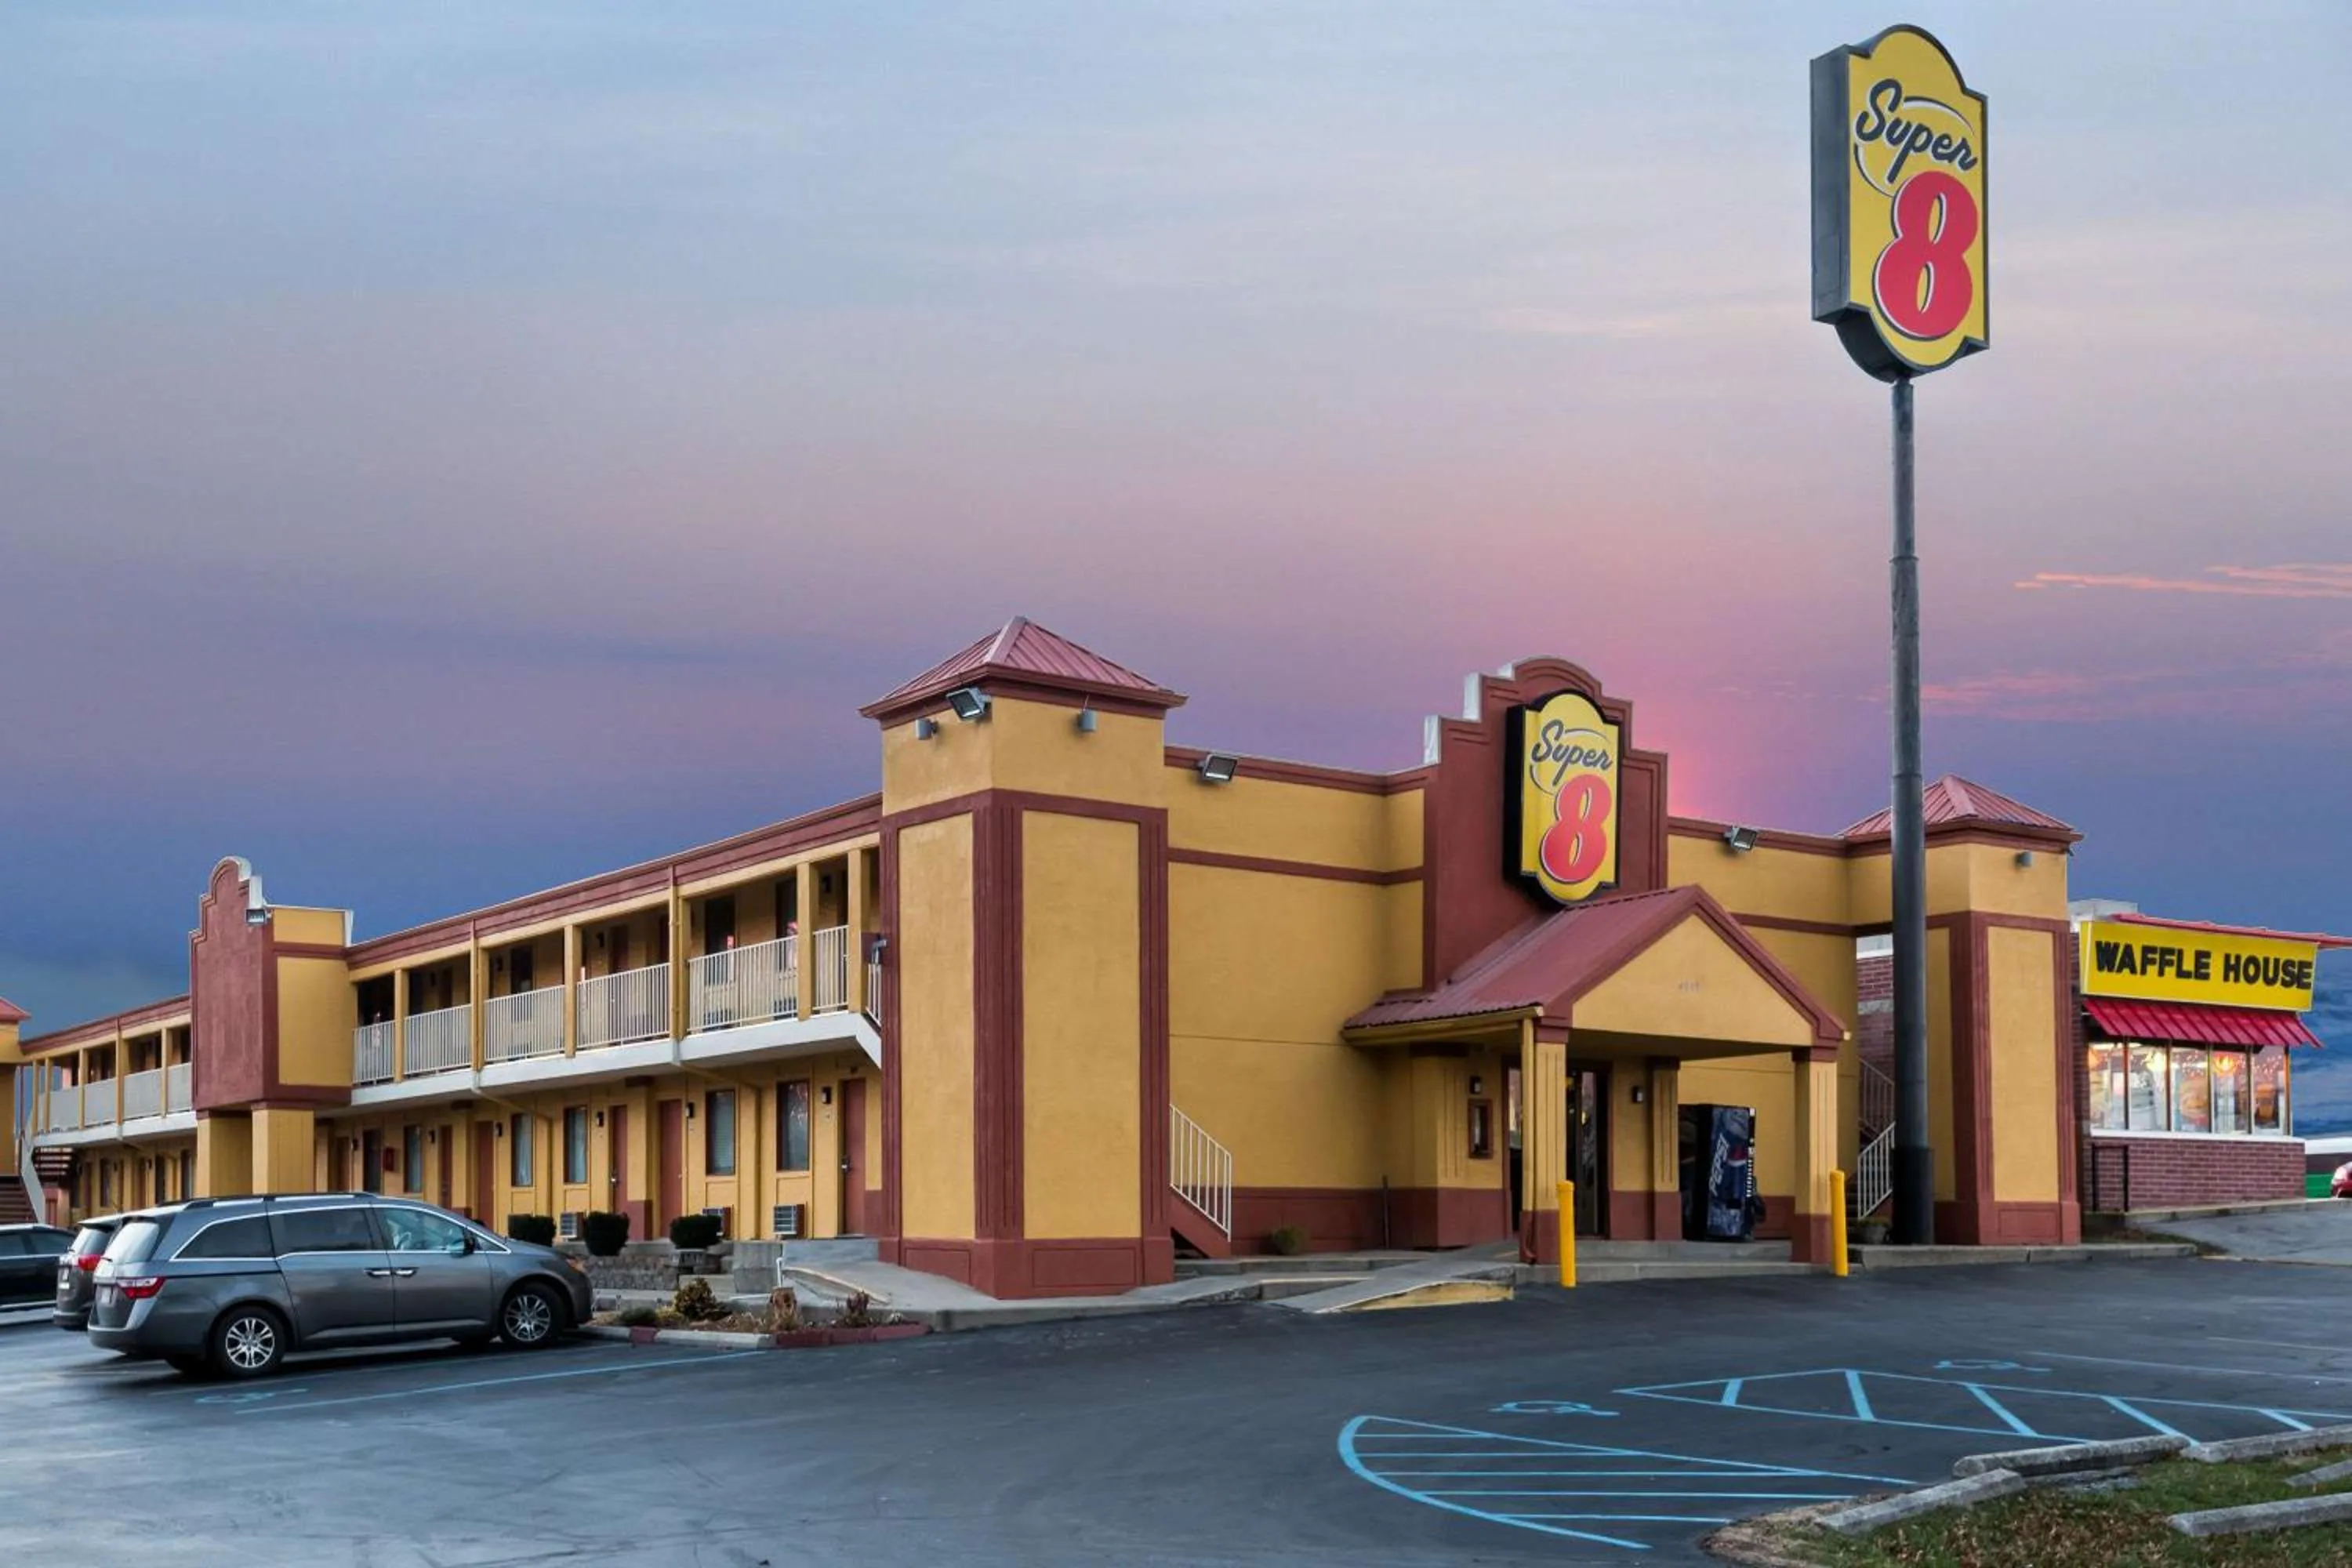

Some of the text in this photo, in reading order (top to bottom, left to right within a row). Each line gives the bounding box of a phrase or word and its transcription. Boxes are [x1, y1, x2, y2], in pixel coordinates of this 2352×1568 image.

[1855, 78, 1978, 184] Super
[1872, 170, 1978, 342] 8
[1531, 719, 1613, 786] Super
[1540, 773, 1612, 884] 8
[2095, 940, 2314, 990] WAFFLE HOUSE
